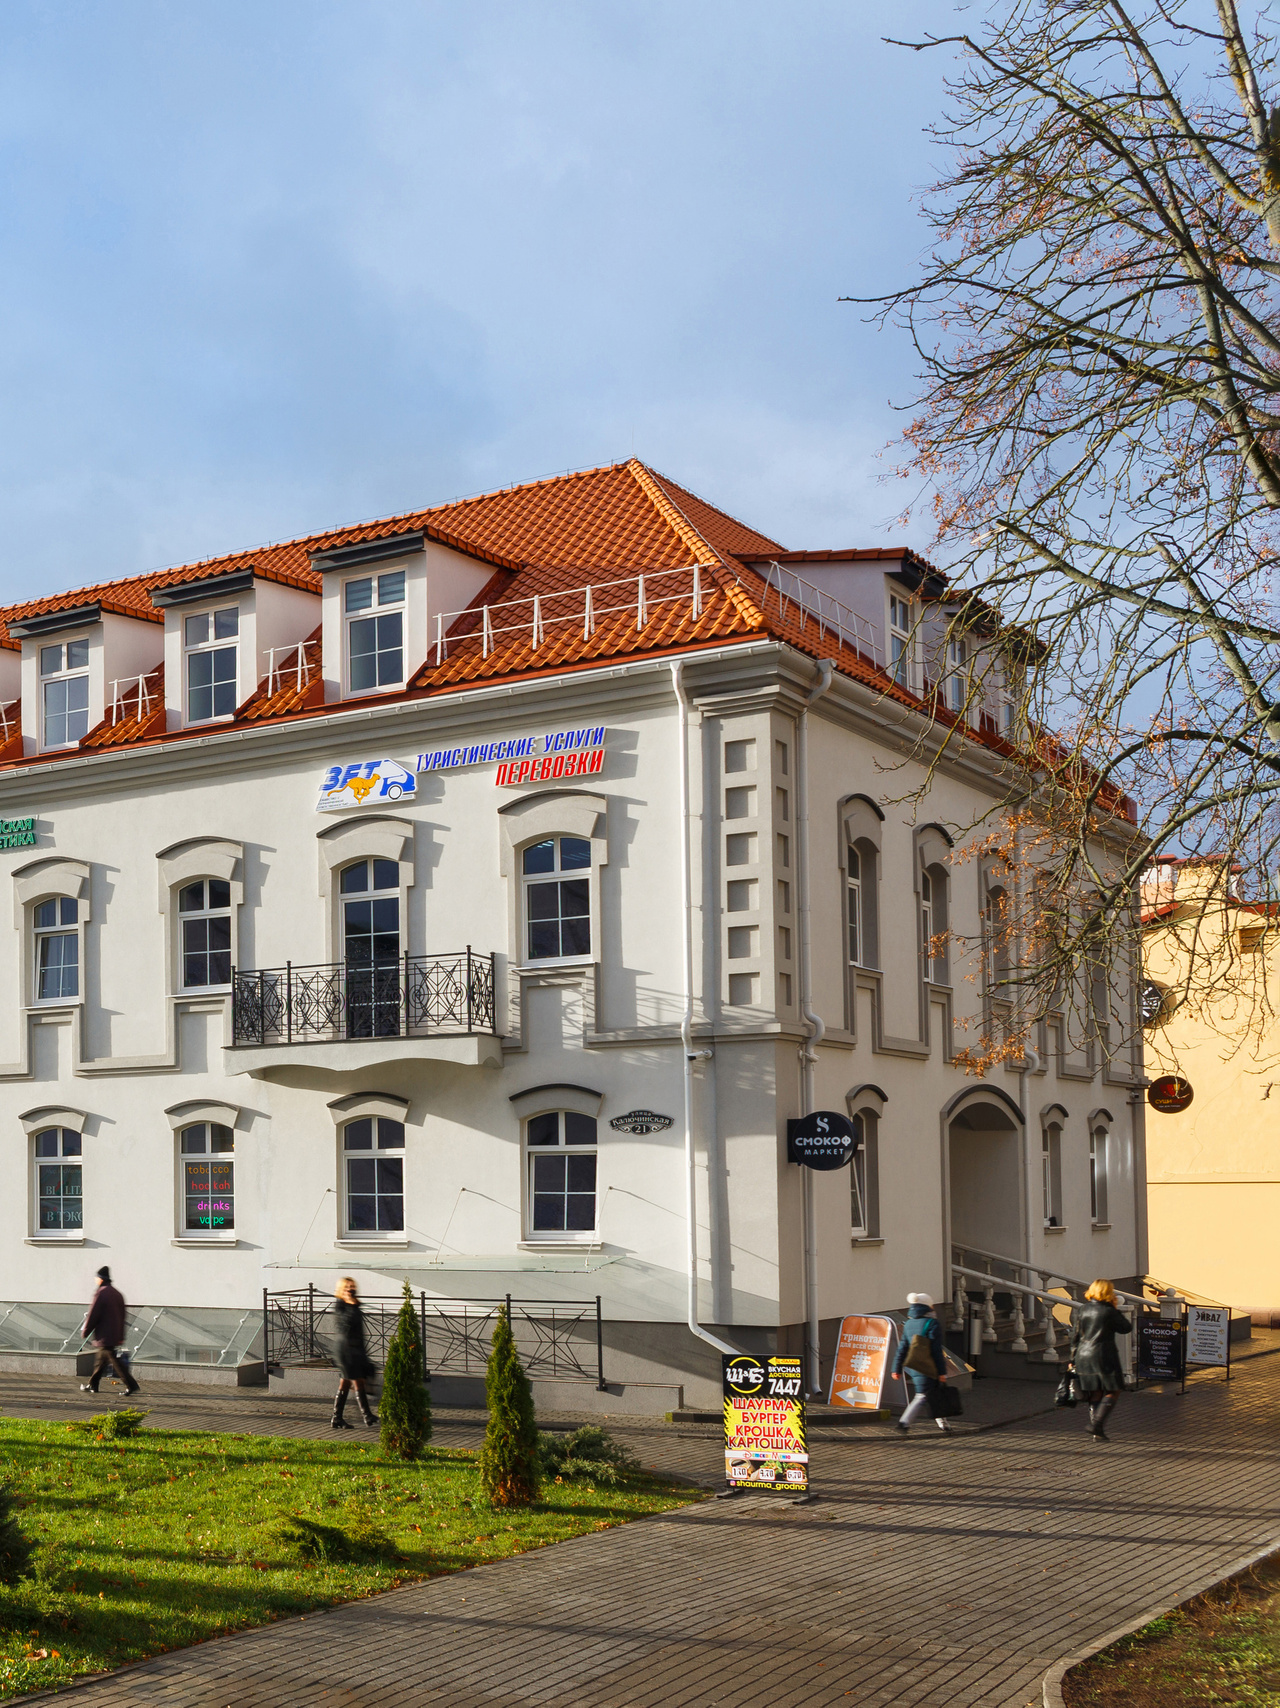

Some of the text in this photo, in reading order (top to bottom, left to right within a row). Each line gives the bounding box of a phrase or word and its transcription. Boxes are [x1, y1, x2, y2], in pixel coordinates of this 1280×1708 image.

[416, 727, 606, 772] ТУРИСТИЧЕСКИЕ УСЛУГИ
[495, 749, 605, 786] ПЕРЕВОЗКИ
[635, 1125, 647, 1133] 21
[795, 1135, 852, 1147] СМОКОФ
[188, 1165, 230, 1174] tobacco
[191, 1180, 231, 1190] hookah
[197, 1200, 230, 1211] drinks
[199, 1216, 225, 1226] vape
[1143, 1328, 1178, 1336] СМОКОФ
[768, 1379, 802, 1395] 7447
[733, 1398, 795, 1411] ШАУРМА
[741, 1412, 787, 1424] БУРГЕР
[735, 1425, 794, 1438] КРОШКА
[728, 1437, 803, 1450] КАРТОШКА
[736, 1480, 806, 1491] shaurma_grodno
